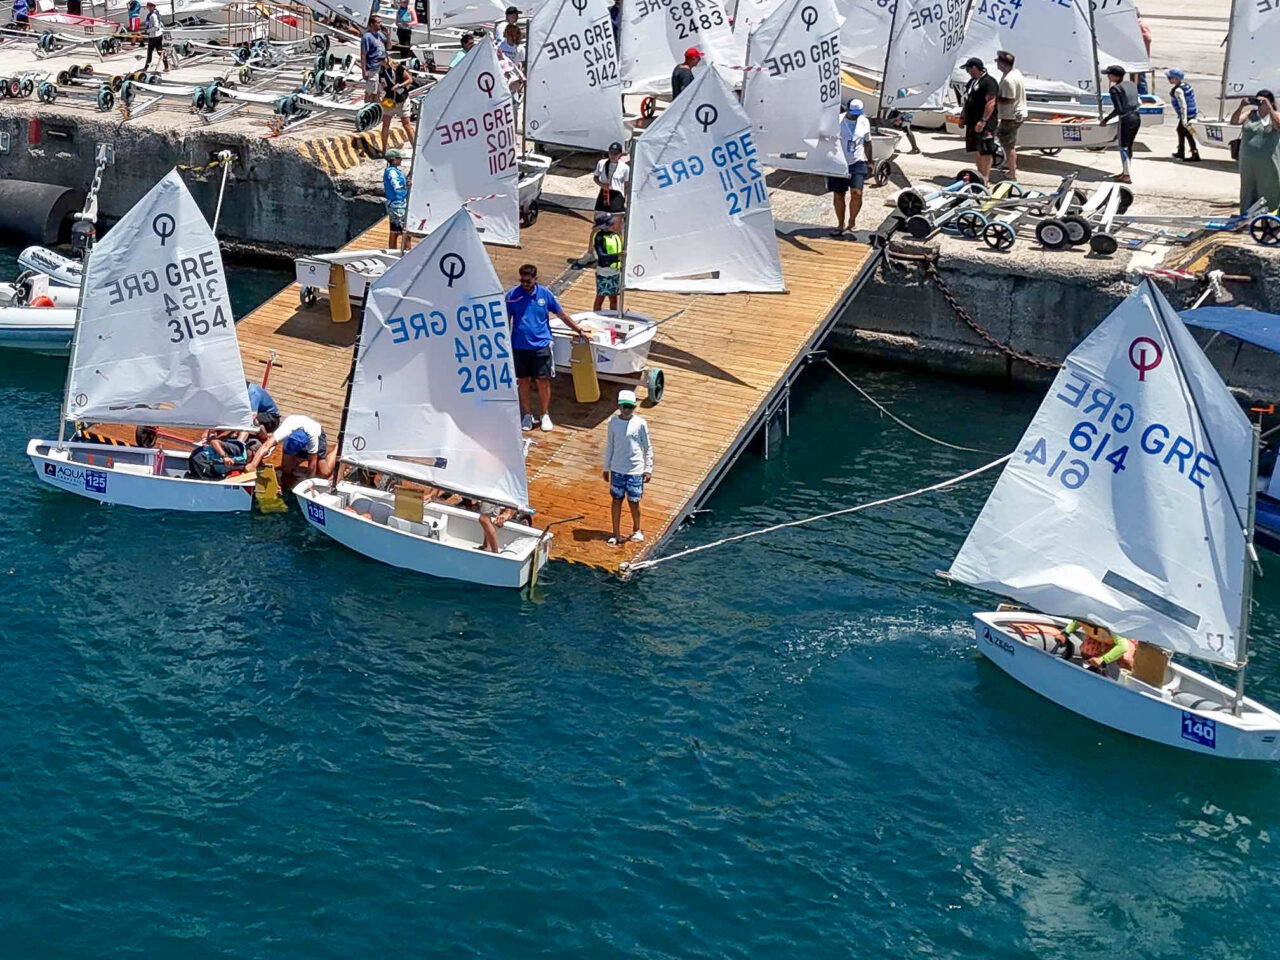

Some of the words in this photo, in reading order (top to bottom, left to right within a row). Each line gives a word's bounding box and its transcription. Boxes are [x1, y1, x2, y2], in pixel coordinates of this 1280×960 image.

[584, 20, 612, 46] GRE
[675, 10, 723, 39] 2483
[810, 35, 840, 63] GRE
[587, 61, 617, 87] 3142
[820, 77, 840, 103] 881
[483, 103, 513, 131] GRE
[489, 147, 516, 175] 1102
[711, 132, 756, 167] GRE
[726, 180, 766, 216] 2711
[165, 250, 218, 287] GRE
[167, 305, 228, 343] 3154
[456, 301, 506, 332] GRE
[457, 362, 513, 393] 2614
[1069, 421, 1129, 474] 614
[1140, 423, 1221, 490] GRE
[57, 467, 86, 480] AQUA
[87, 475, 106, 488] 125
[1184, 719, 1214, 740] 140
